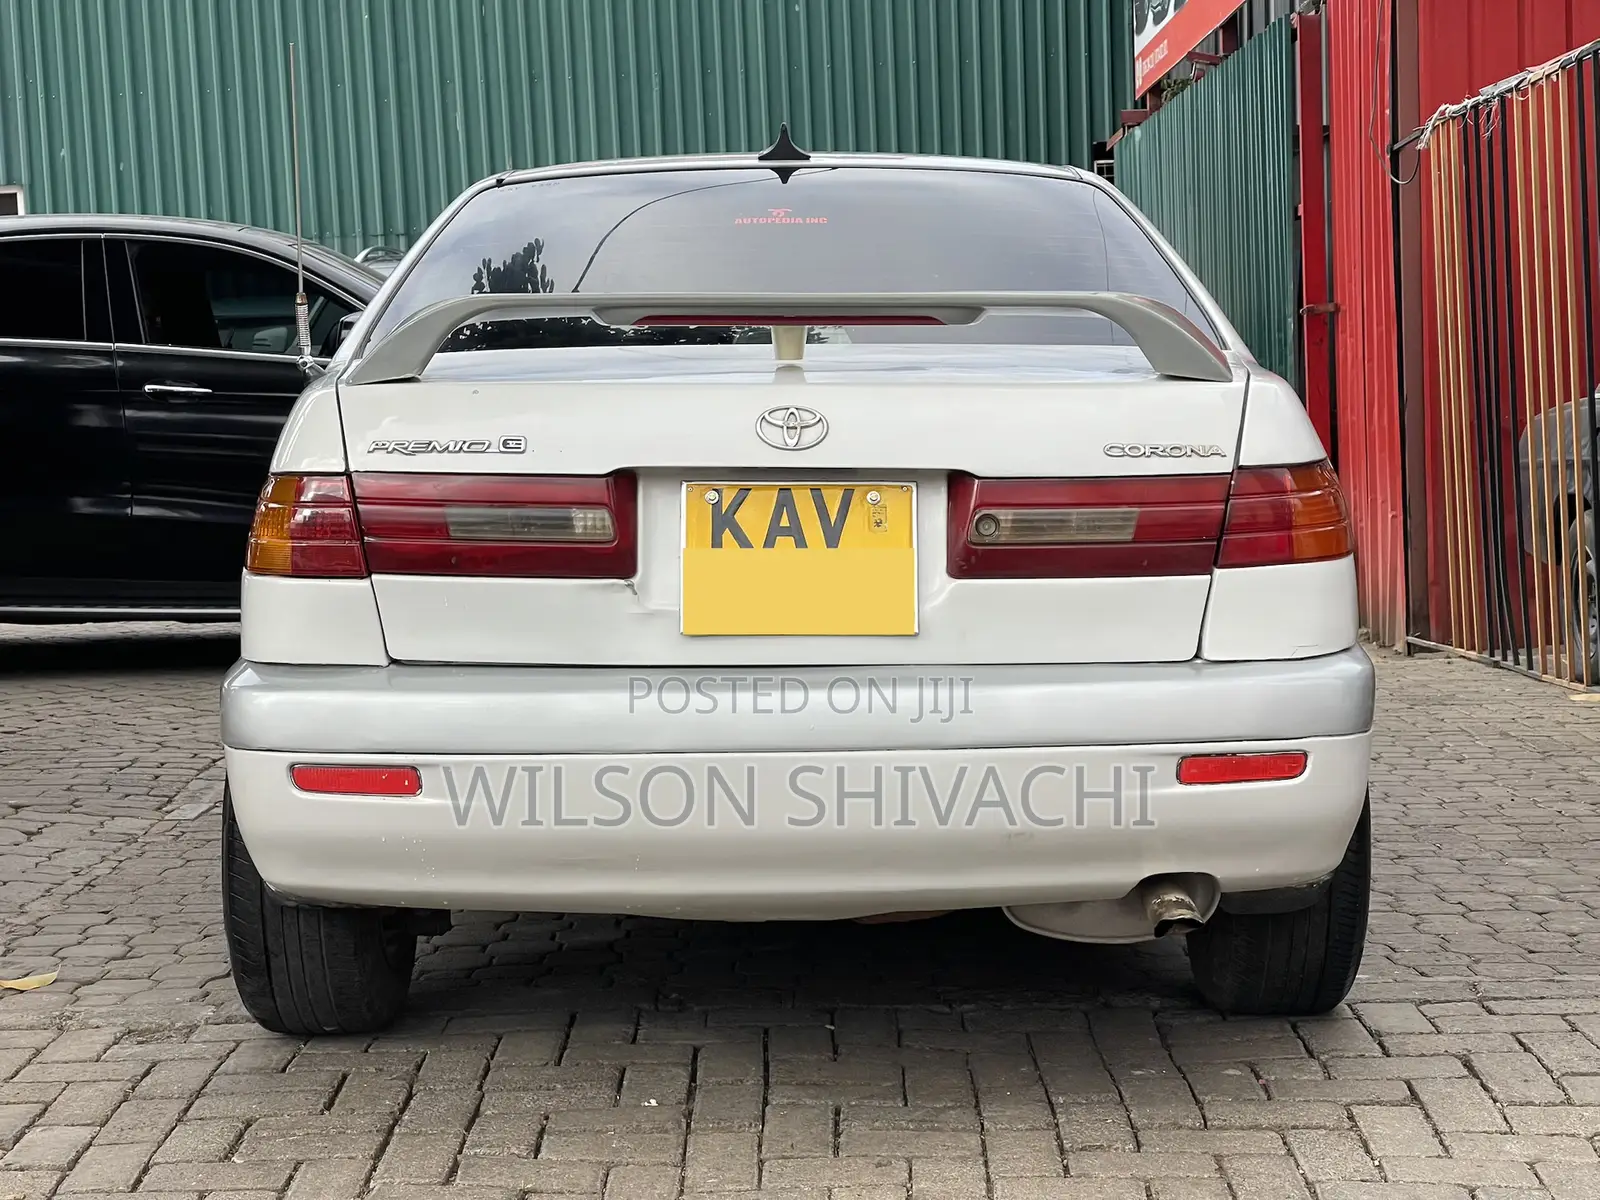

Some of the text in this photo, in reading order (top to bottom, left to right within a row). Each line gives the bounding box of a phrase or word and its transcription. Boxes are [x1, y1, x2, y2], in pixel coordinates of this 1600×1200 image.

[367, 440, 491, 456] PREMIO
[1103, 442, 1227, 458] CORONA
[710, 488, 855, 549] KAV
